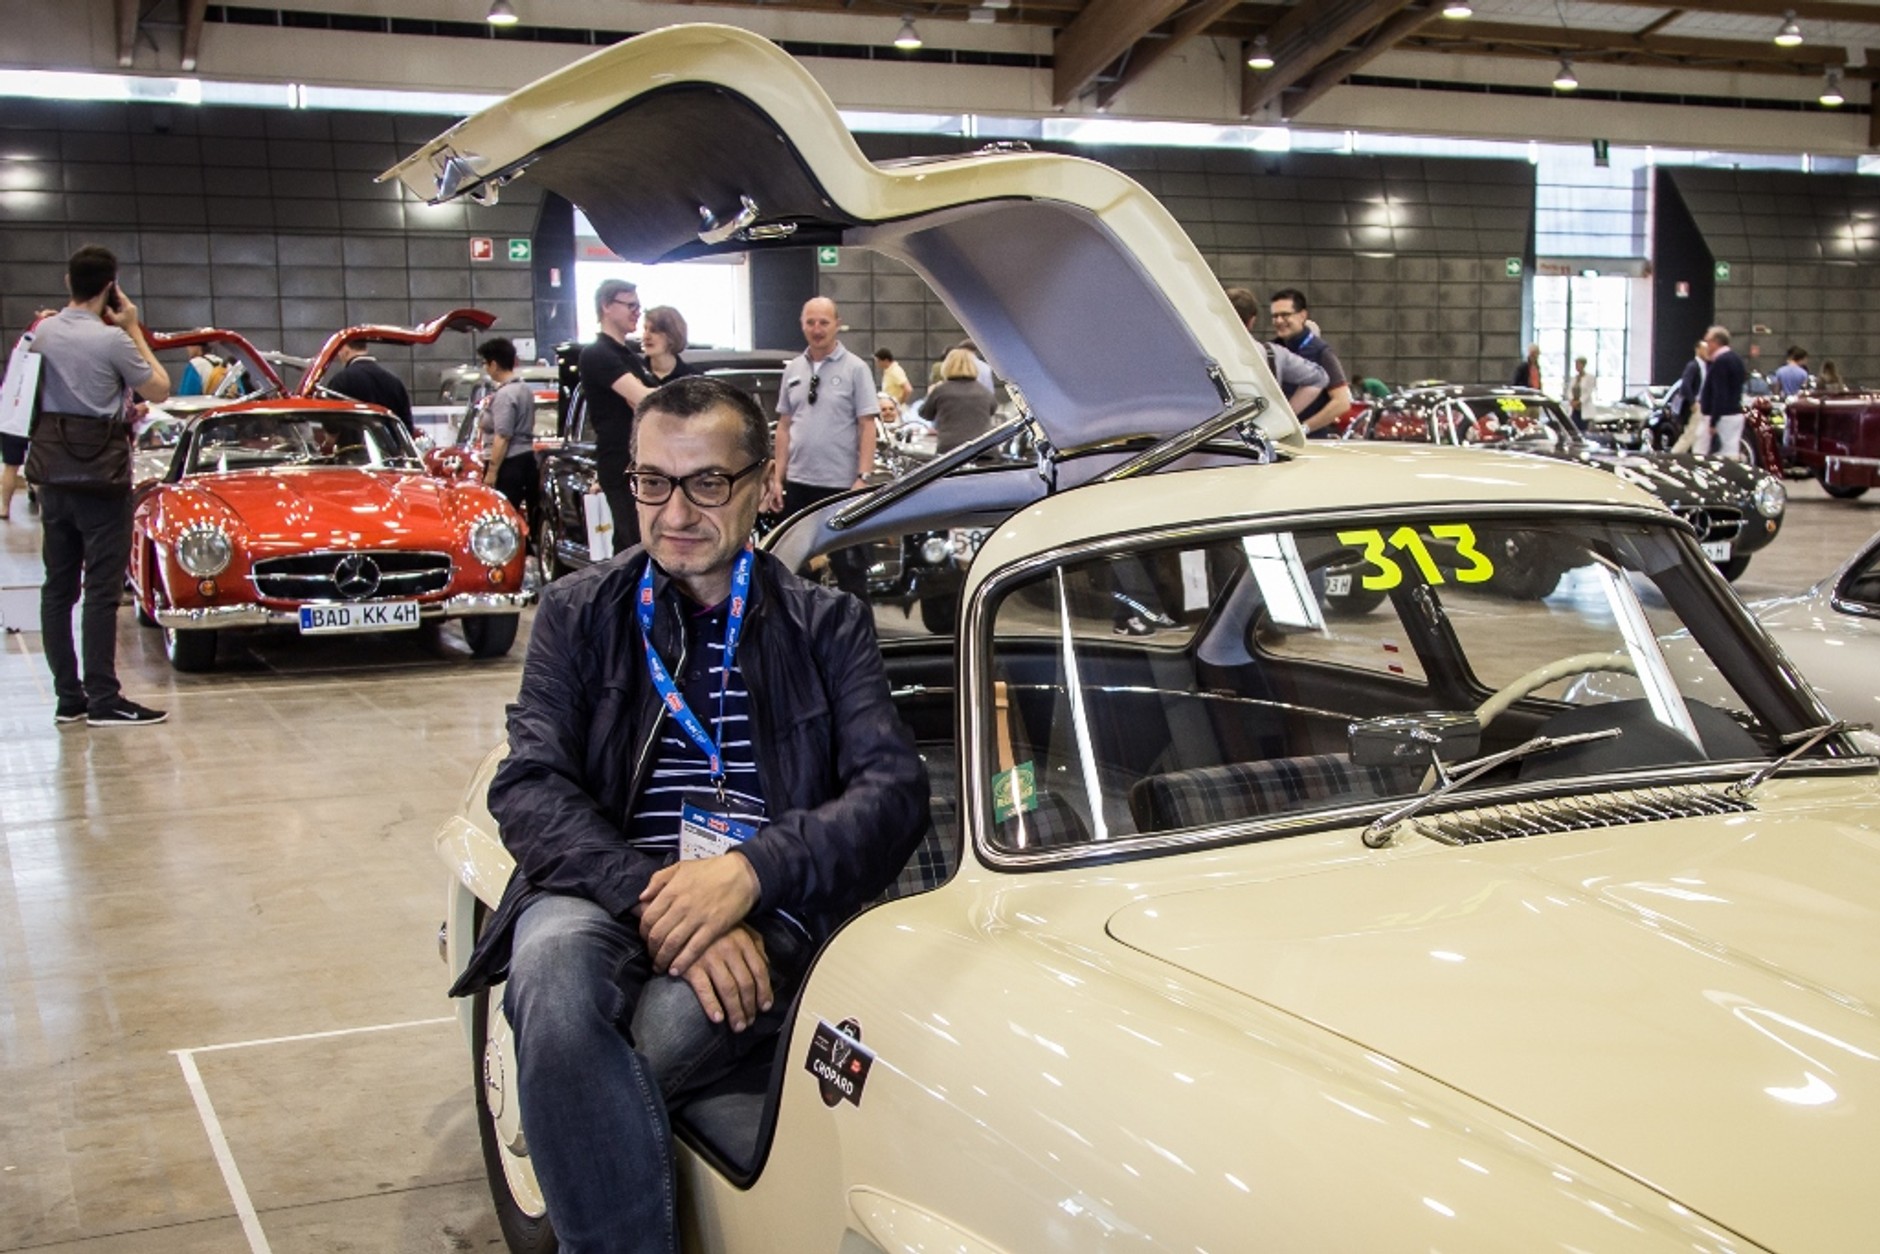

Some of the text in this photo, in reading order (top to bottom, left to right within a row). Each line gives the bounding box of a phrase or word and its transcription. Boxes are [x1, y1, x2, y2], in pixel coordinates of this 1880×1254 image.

[1336, 523, 1494, 590] 313
[312, 608, 350, 627] BAD
[363, 605, 388, 624] KK
[393, 604, 417, 622] 4H
[813, 1058, 854, 1095] CHOPARD
